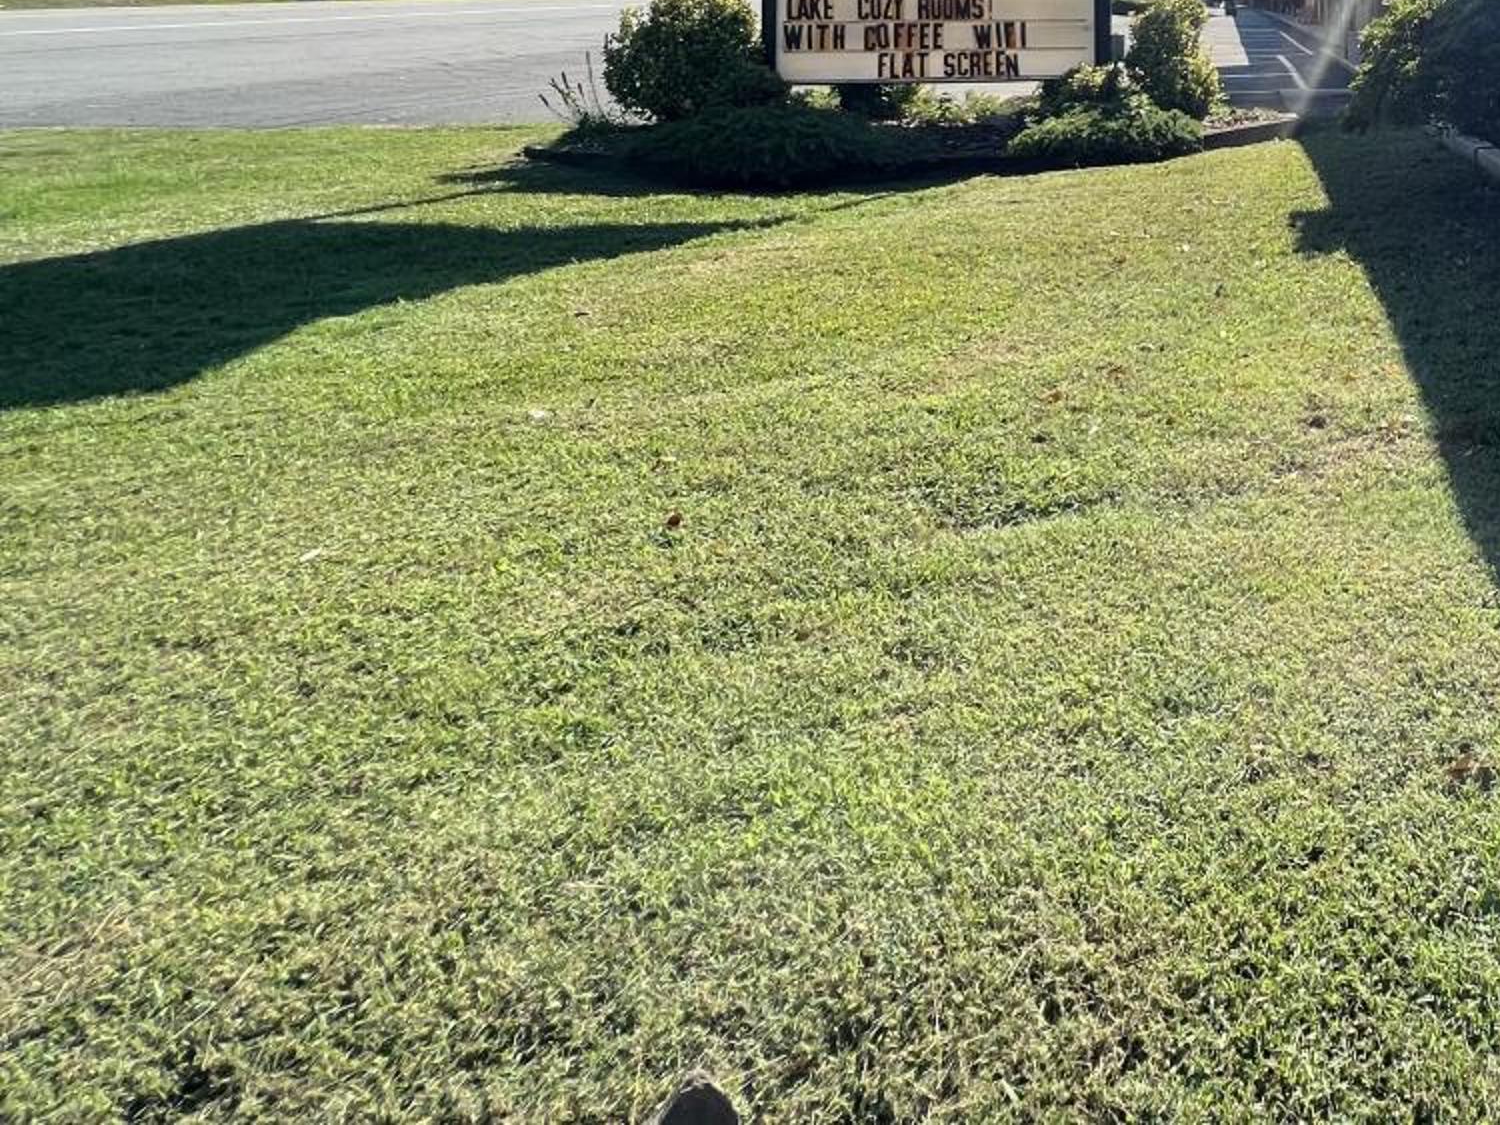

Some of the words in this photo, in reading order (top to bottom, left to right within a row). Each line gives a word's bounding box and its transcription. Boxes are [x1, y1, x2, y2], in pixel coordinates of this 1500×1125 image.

[784, 24, 846, 50] WITH
[863, 21, 943, 51] COFFEE
[972, 21, 1026, 50] WIFI
[877, 52, 929, 79] FLAT
[943, 50, 1019, 77] SCREEN
